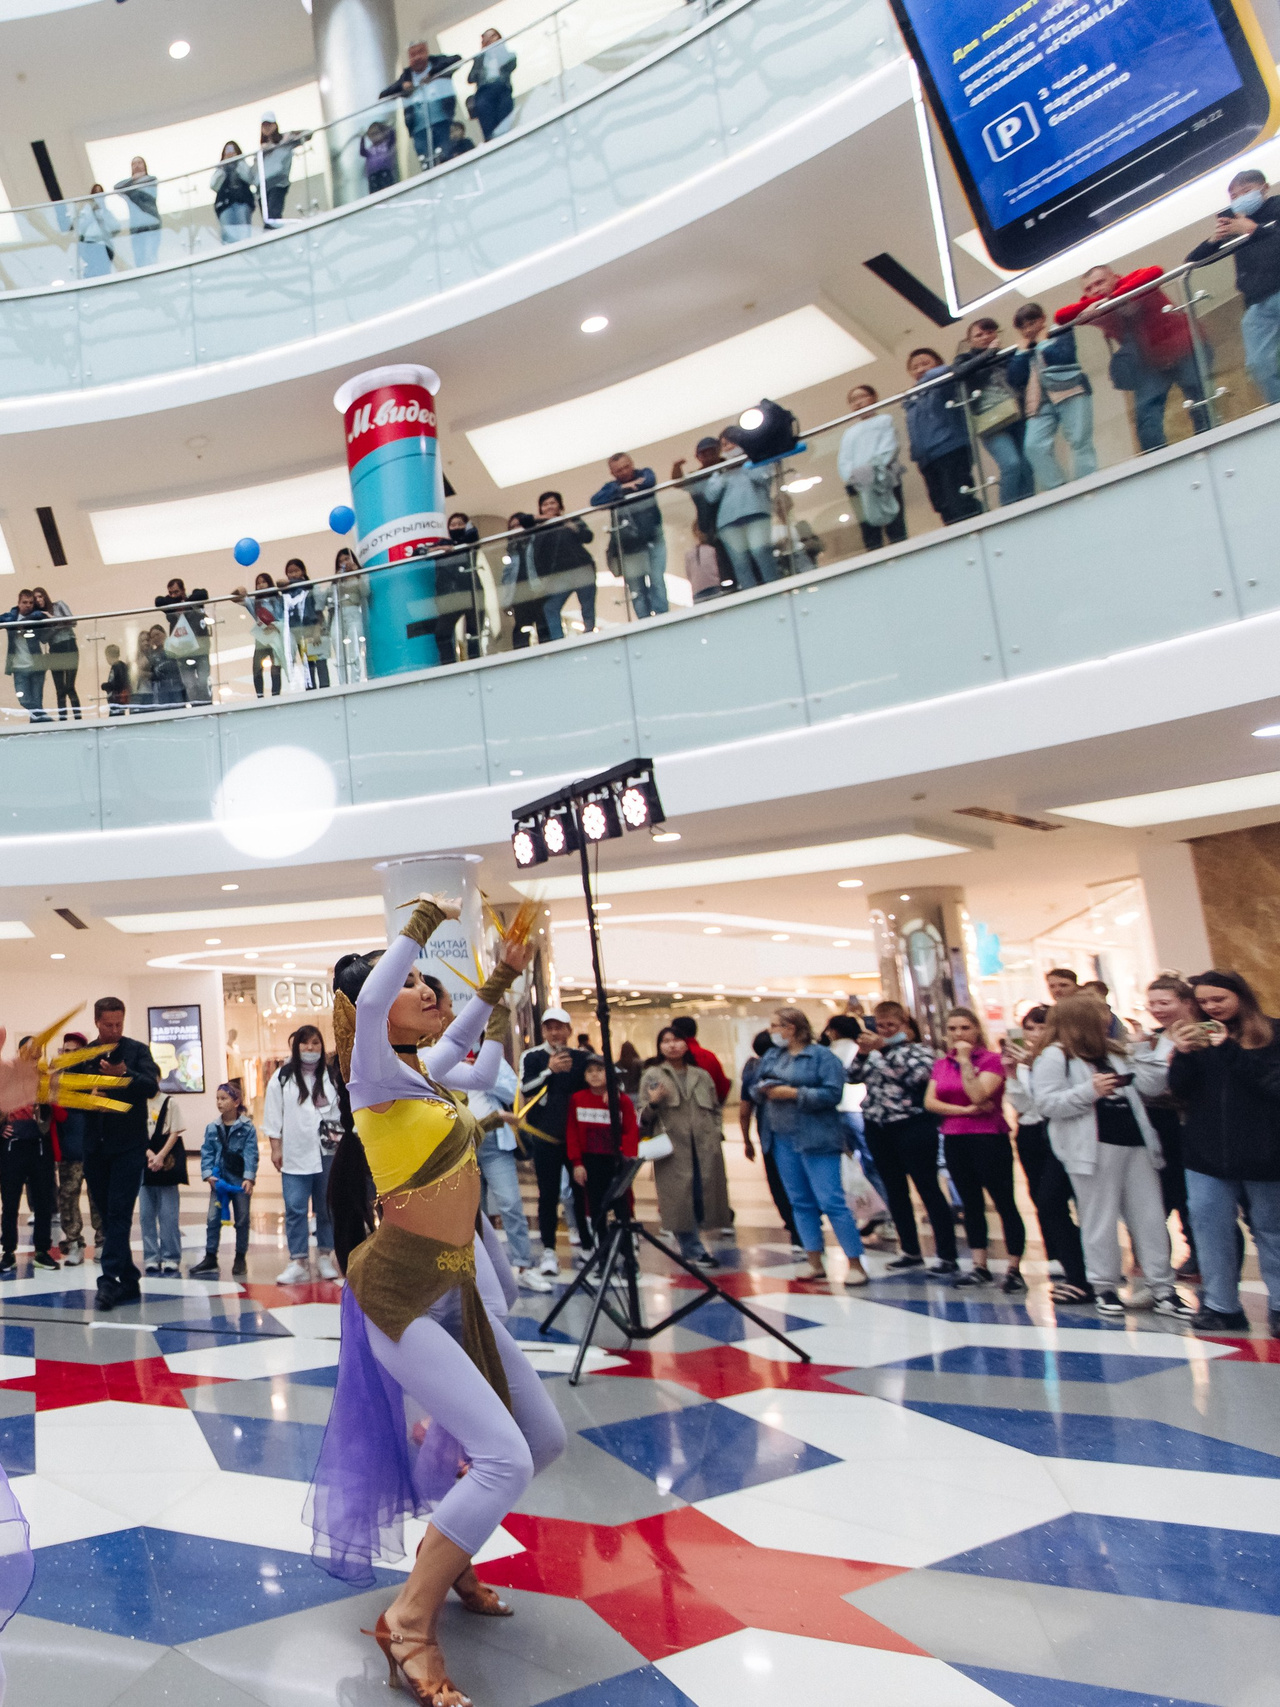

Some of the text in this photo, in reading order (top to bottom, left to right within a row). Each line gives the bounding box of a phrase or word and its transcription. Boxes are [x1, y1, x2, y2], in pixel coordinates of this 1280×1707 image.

[953, 38, 979, 64] Для
[964, 41, 1036, 97] ресторана
[1037, 64, 1088, 100] 3 часа
[1043, 62, 1117, 114] парковки
[1048, 72, 1130, 127] бесплатно
[996, 117, 1022, 149] P
[348, 398, 436, 443] М.видео
[430, 938, 467, 949] ЧИТАЙ
[431, 949, 469, 959] ГОРОД
